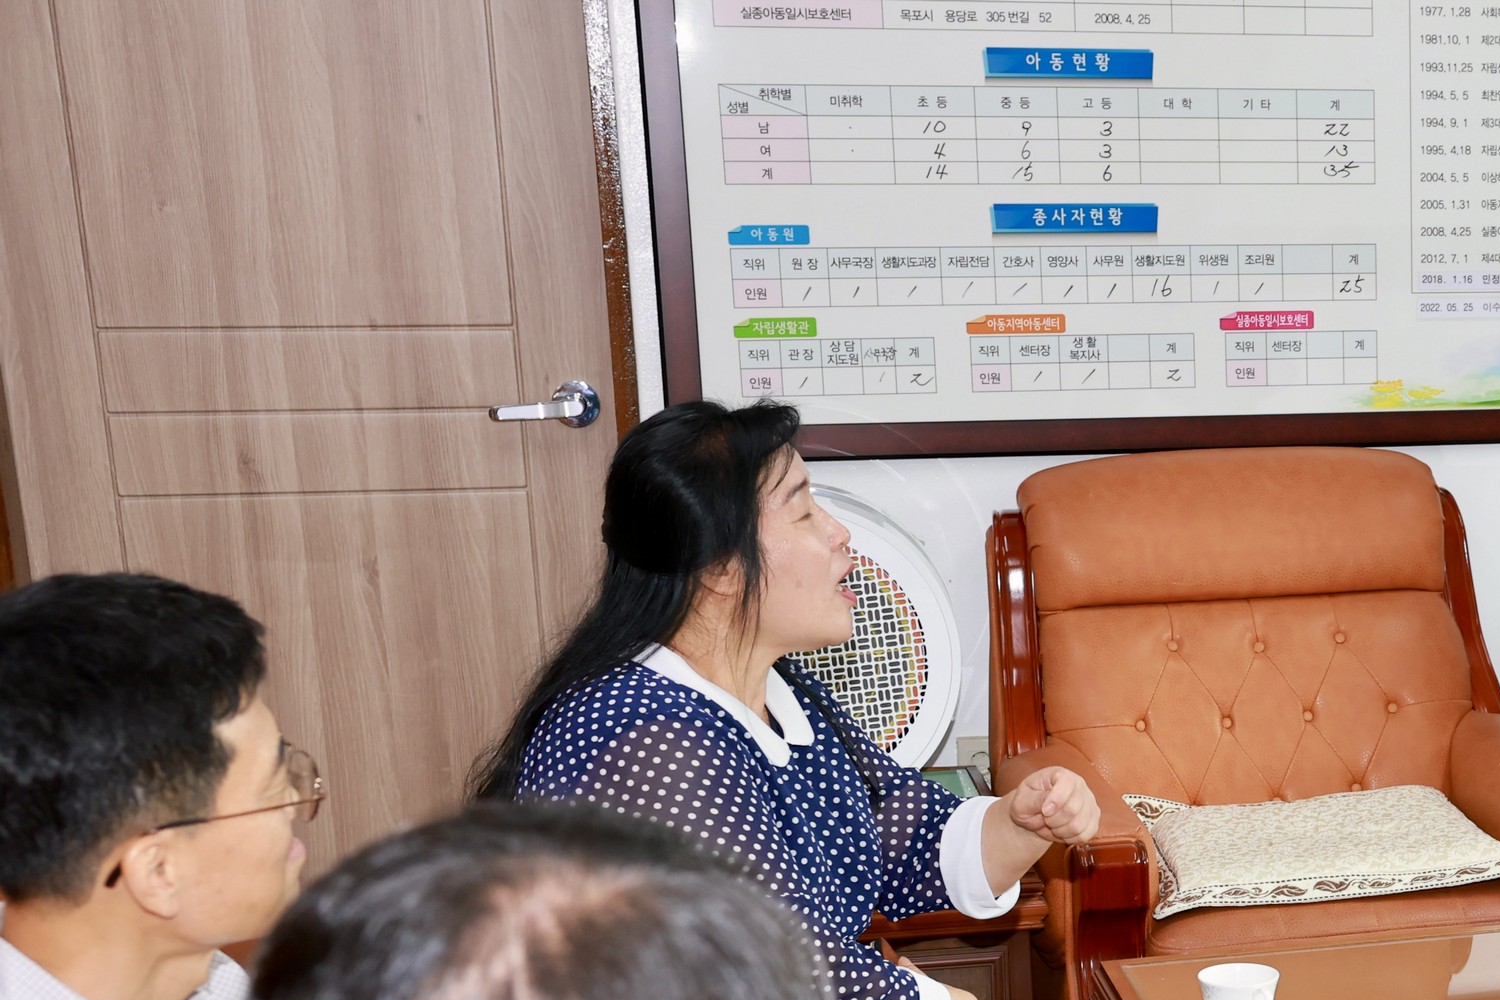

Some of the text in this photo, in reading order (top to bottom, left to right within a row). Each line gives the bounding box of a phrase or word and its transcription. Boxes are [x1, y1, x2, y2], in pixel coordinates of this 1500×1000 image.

[741, 7, 851, 20] 실종아동일시보호센터
[901, 9, 1052, 23] 목포시 용당로 305 번길 52
[727, 101, 750, 114] 성별
[758, 122, 769, 134] 남
[923, 121, 1349, 136] 10 9 3 22
[760, 145, 771, 157] 여
[934, 140, 1348, 160] 4 6 3 13
[762, 168, 772, 179] 계
[926, 164, 948, 179] 14
[1103, 165, 1112, 181] 6
[1033, 207, 1123, 226] 종사자현황
[751, 228, 794, 241] 아동원
[743, 259, 765, 270] 직위
[831, 257, 873, 269] 사무국장
[882, 256, 936, 269] 생활지도과장
[948, 256, 989, 268] 자립전담
[1003, 256, 1034, 268] 간호사
[1048, 256, 1078, 268] 영양사
[1093, 255, 1123, 267] 사무원
[1135, 255, 1185, 267] 생활지도원
[1199, 254, 1228, 266] 위생원
[1245, 254, 1274, 265] 조리원
[1349, 254, 1358, 265] 계
[1151, 275, 1365, 297] 16 25
[745, 288, 767, 300] 인원
[986, 316, 1061, 331] 아동지역아동센터
[1236, 314, 1308, 327] 실종아동일시보호센터
[753, 321, 809, 335] 자립생활관
[909, 347, 919, 358] 계
[979, 343, 1176, 360] 직위 센터장 복지사 계
[1235, 340, 1364, 352] 직위 센터장 계
[748, 349, 769, 361] 직위
[827, 354, 858, 365] 지도원
[980, 373, 1000, 384] 인원
[1235, 368, 1255, 379] 인원
[750, 377, 771, 389] 인원
